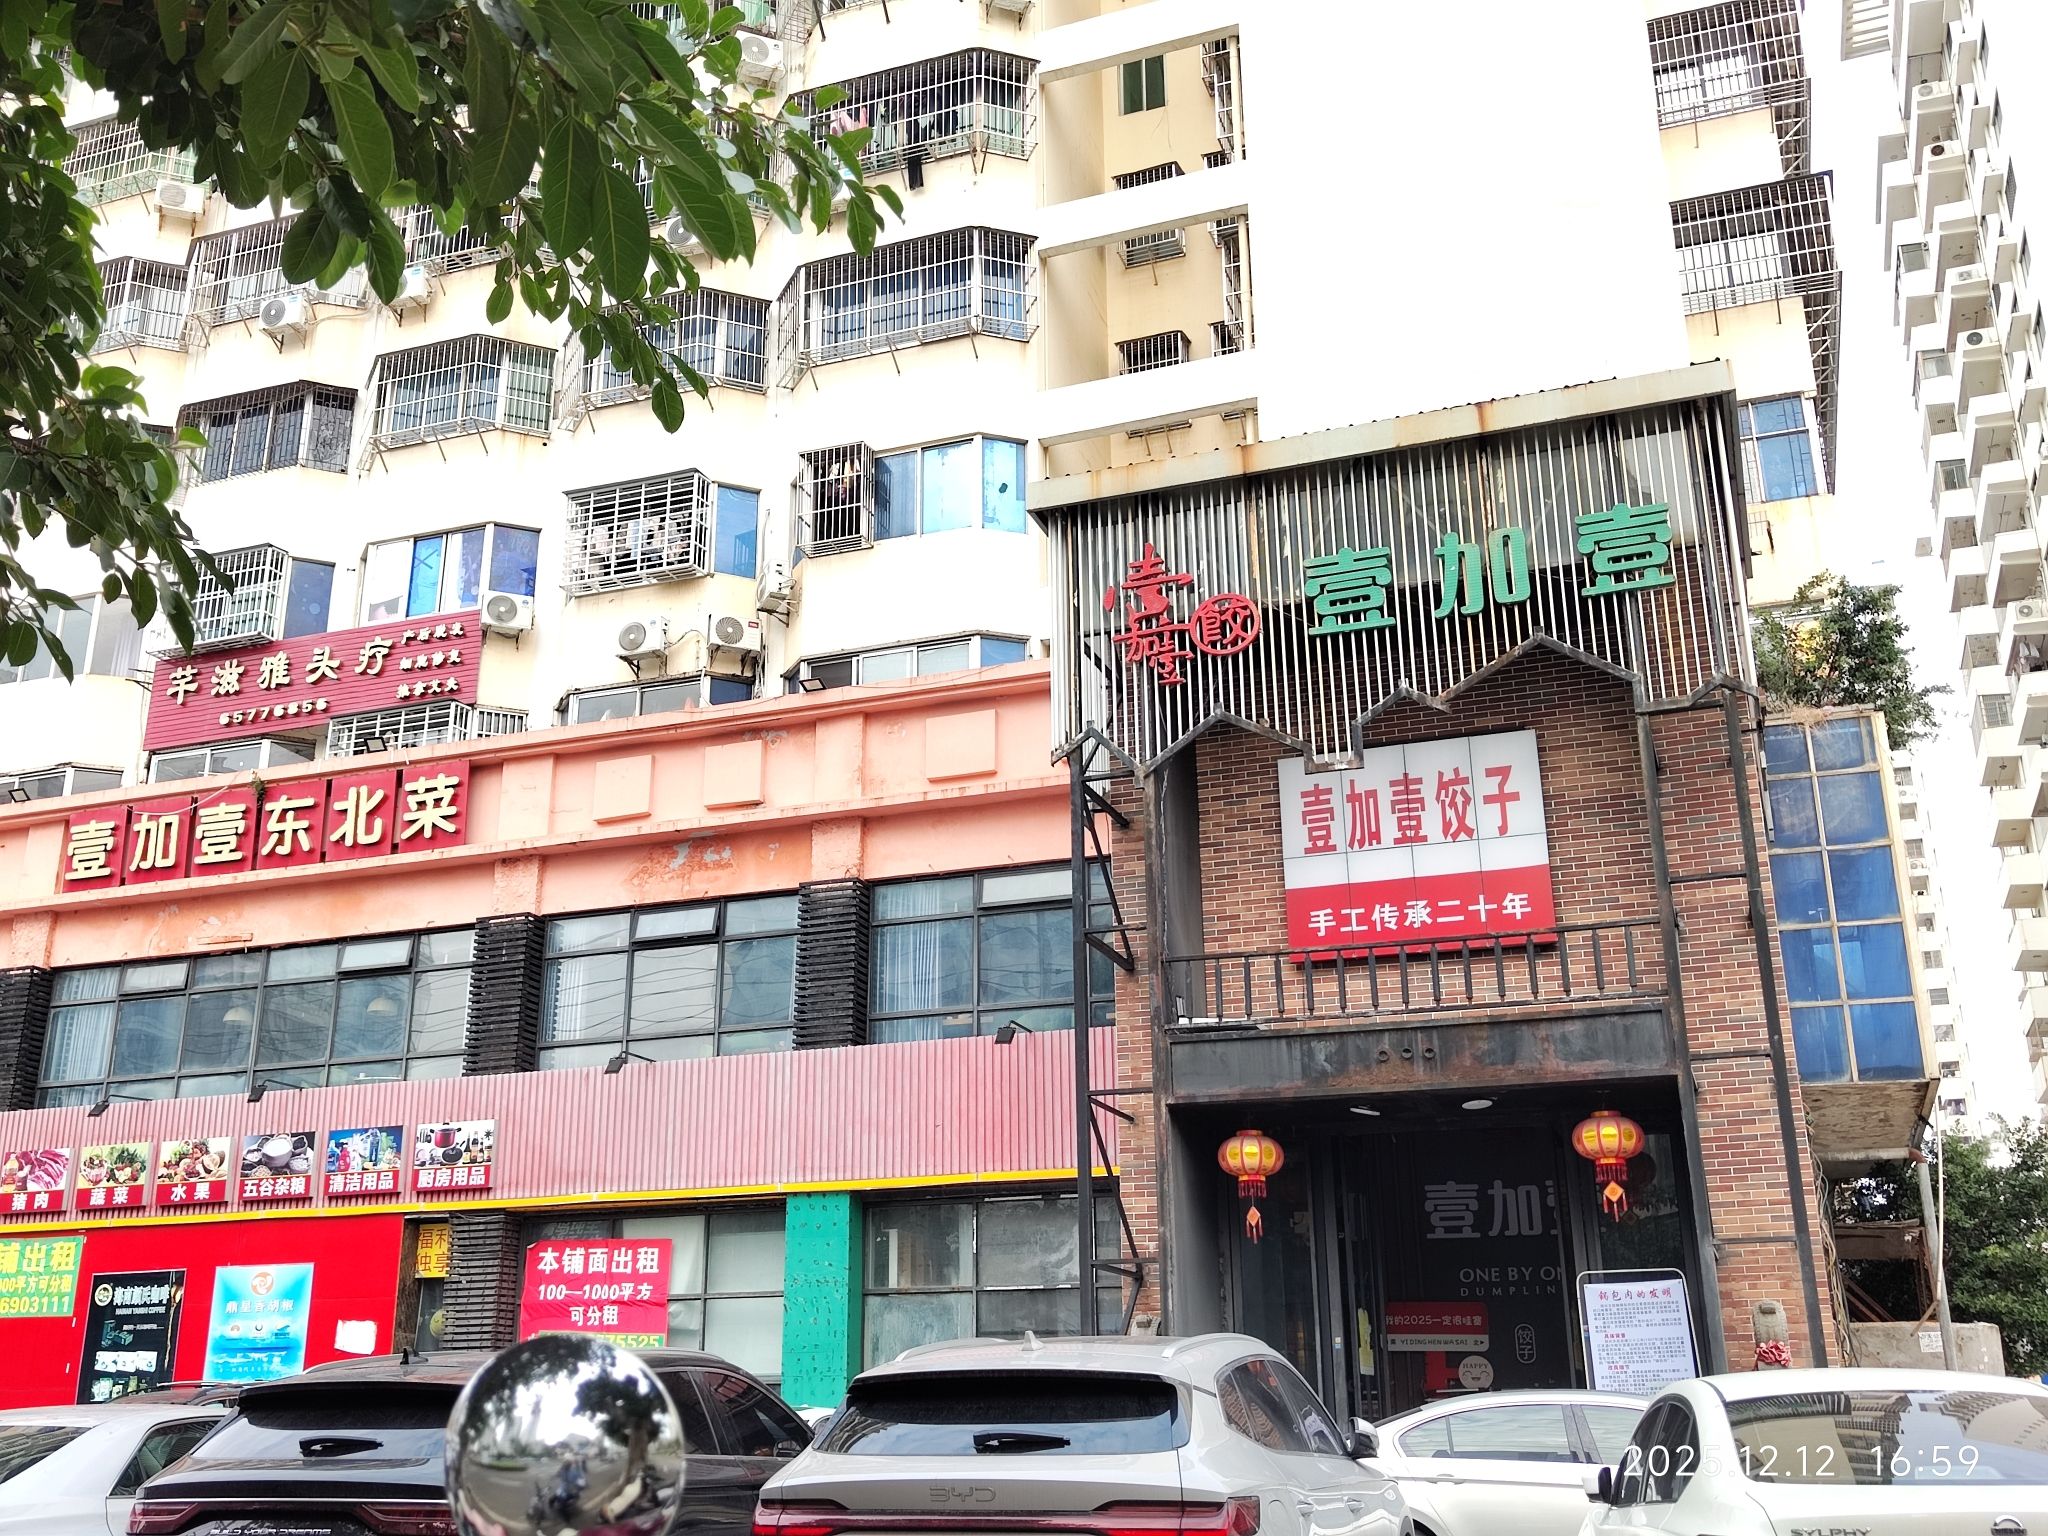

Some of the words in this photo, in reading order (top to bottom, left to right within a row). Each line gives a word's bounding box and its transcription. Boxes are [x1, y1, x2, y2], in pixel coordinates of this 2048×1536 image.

[1303, 502, 1677, 636] 壹加壹
[1300, 765, 1521, 855] 壹加壹饺子
[64, 773, 461, 881] 壹加壹东北菜
[1308, 892, 1532, 937] 手工传承二十年
[243, 1177, 306, 1198] 五谷杂粮
[328, 1170, 394, 1194] 清洁用品
[417, 1166, 486, 1189] 厨房用品
[12, 1192, 49, 1211] 猪肉
[89, 1186, 130, 1206] 蔬菜
[170, 1181, 210, 1202] 水果
[1424, 1180, 1558, 1239] 壹加
[538, 1247, 660, 1275] 本铺面出租
[1459, 1268, 1500, 1283] ONE
[1508, 1267, 1533, 1281] BY
[569, 1306, 618, 1326] 可分租
[929, 1486, 996, 1503] BYD
